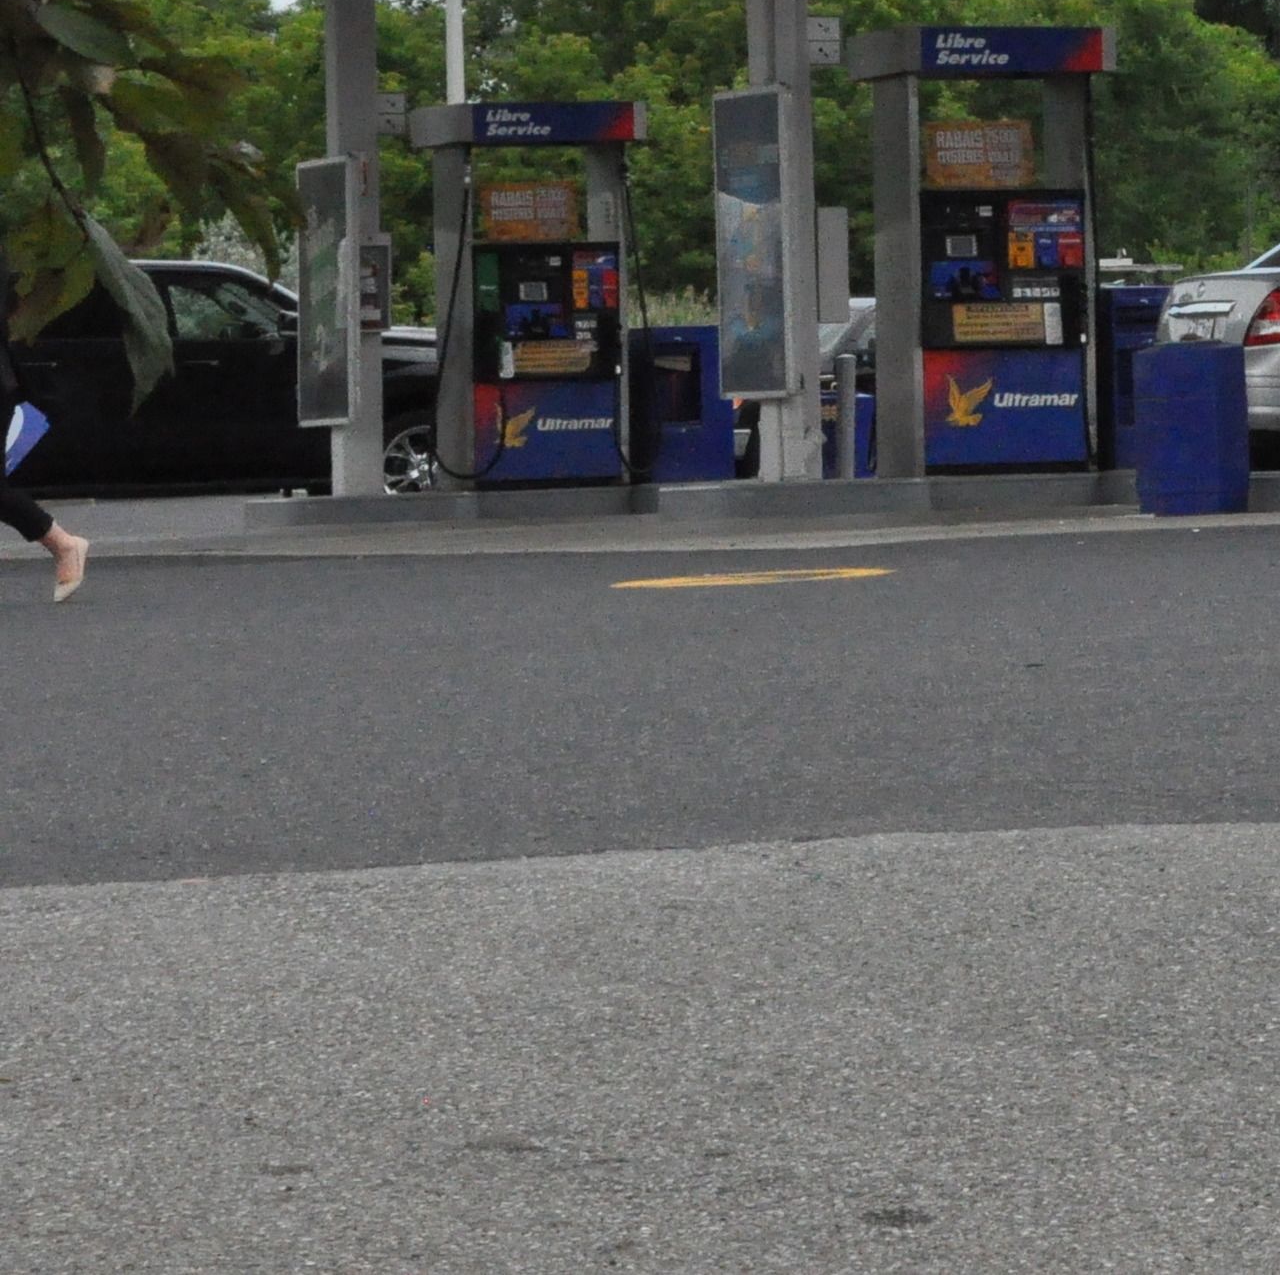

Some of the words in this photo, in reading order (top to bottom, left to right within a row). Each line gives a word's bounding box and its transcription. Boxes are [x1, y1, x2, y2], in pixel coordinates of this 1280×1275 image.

[936, 33, 986, 48] Libre
[936, 50, 1009, 65] Service
[486, 109, 531, 122] Libre
[487, 122, 551, 136] Service
[994, 392, 1078, 407] Ultramar
[537, 418, 613, 431] Ultramar
